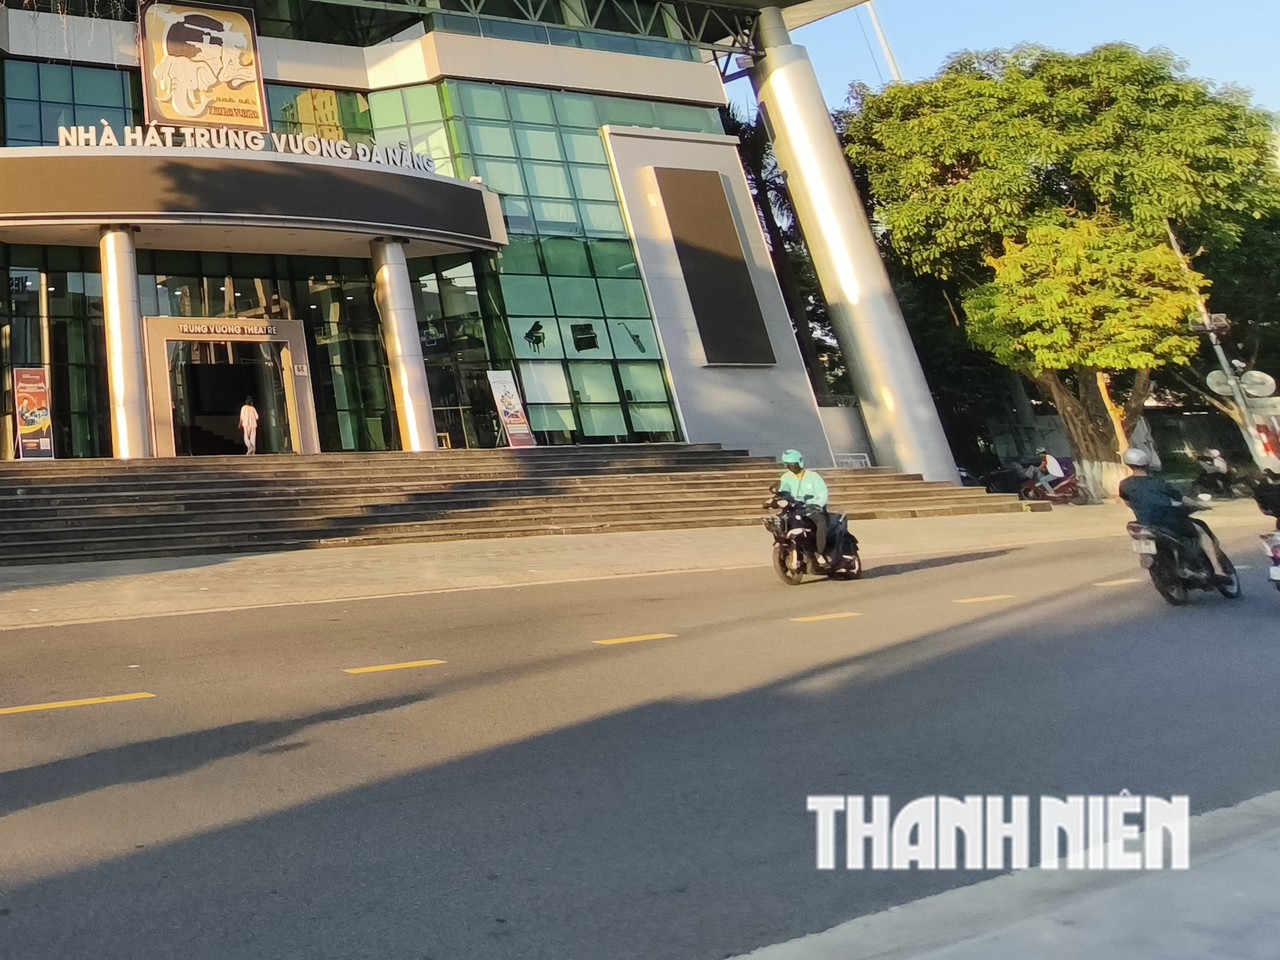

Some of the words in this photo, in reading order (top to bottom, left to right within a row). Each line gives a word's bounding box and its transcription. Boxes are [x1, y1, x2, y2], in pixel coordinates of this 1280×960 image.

[58, 119, 119, 147] NHÀ
[124, 120, 175, 147] HÁT
[180, 125, 265, 151] TRƯNG
[271, 132, 352, 160] VƯƠNG
[356, 139, 385, 165] ĐÀ
[385, 141, 436, 173] NẴNG
[179, 324, 208, 334] TRUNG
[209, 324, 241, 335] VUONG
[243, 325, 278, 335] THEATRE
